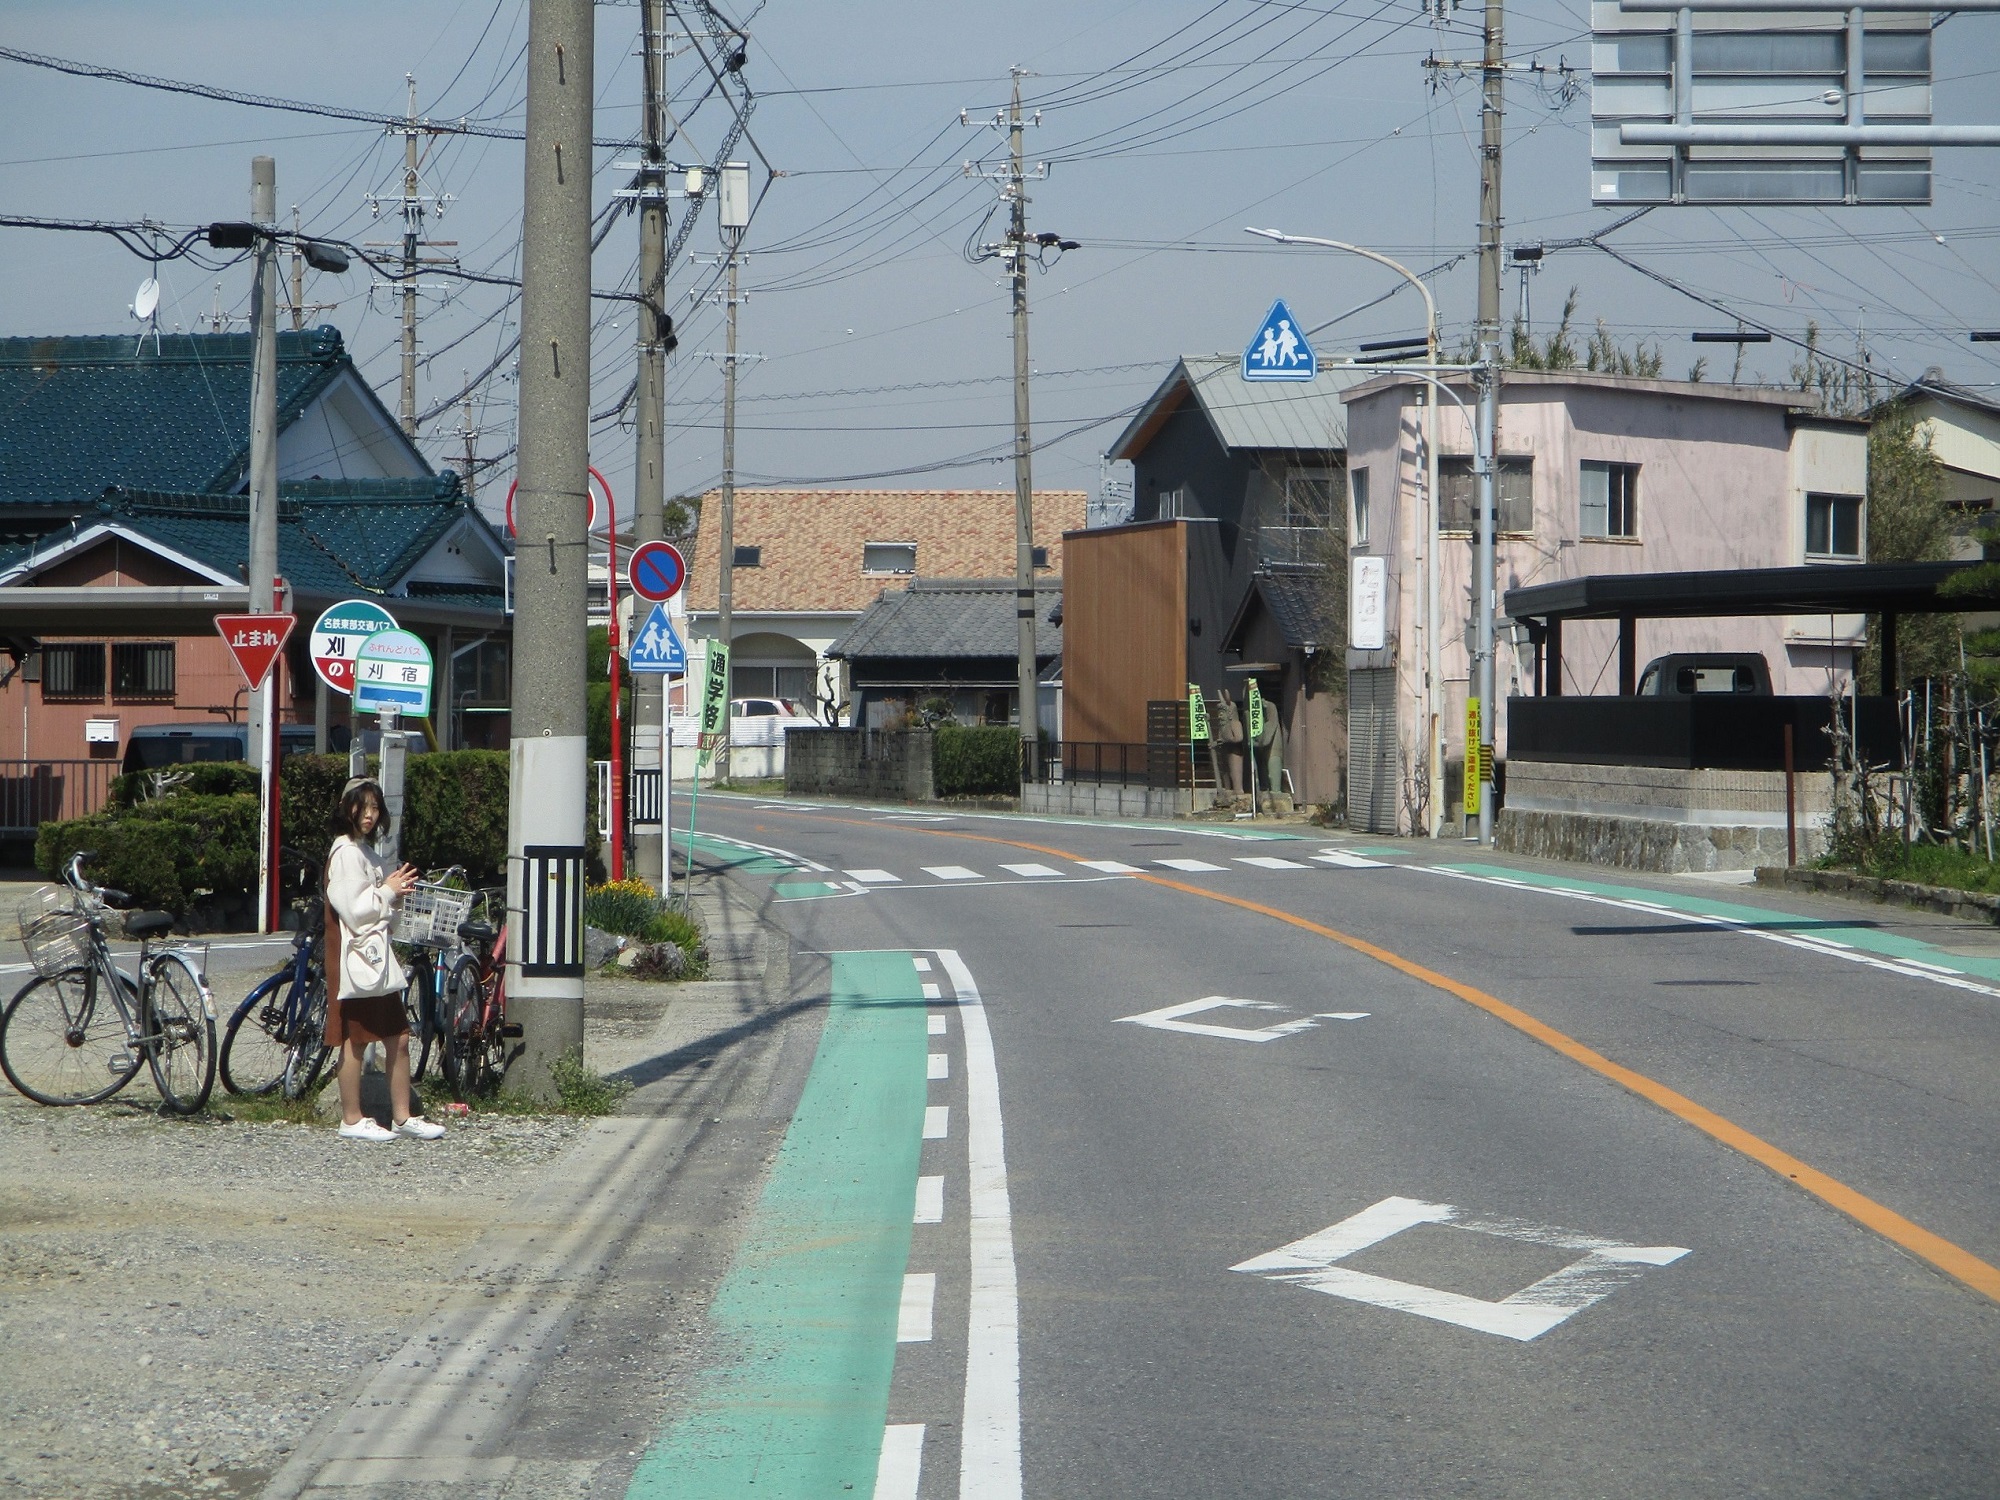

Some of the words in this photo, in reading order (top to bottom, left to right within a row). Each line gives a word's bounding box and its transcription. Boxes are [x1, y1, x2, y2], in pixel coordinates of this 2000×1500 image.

[323, 618, 391, 632] 名鉄東部交通バス
[232, 629, 279, 648] 止まれ
[325, 636, 345, 657] 刈
[368, 643, 421, 656] ふれんどバス
[705, 651, 725, 730] 通学路
